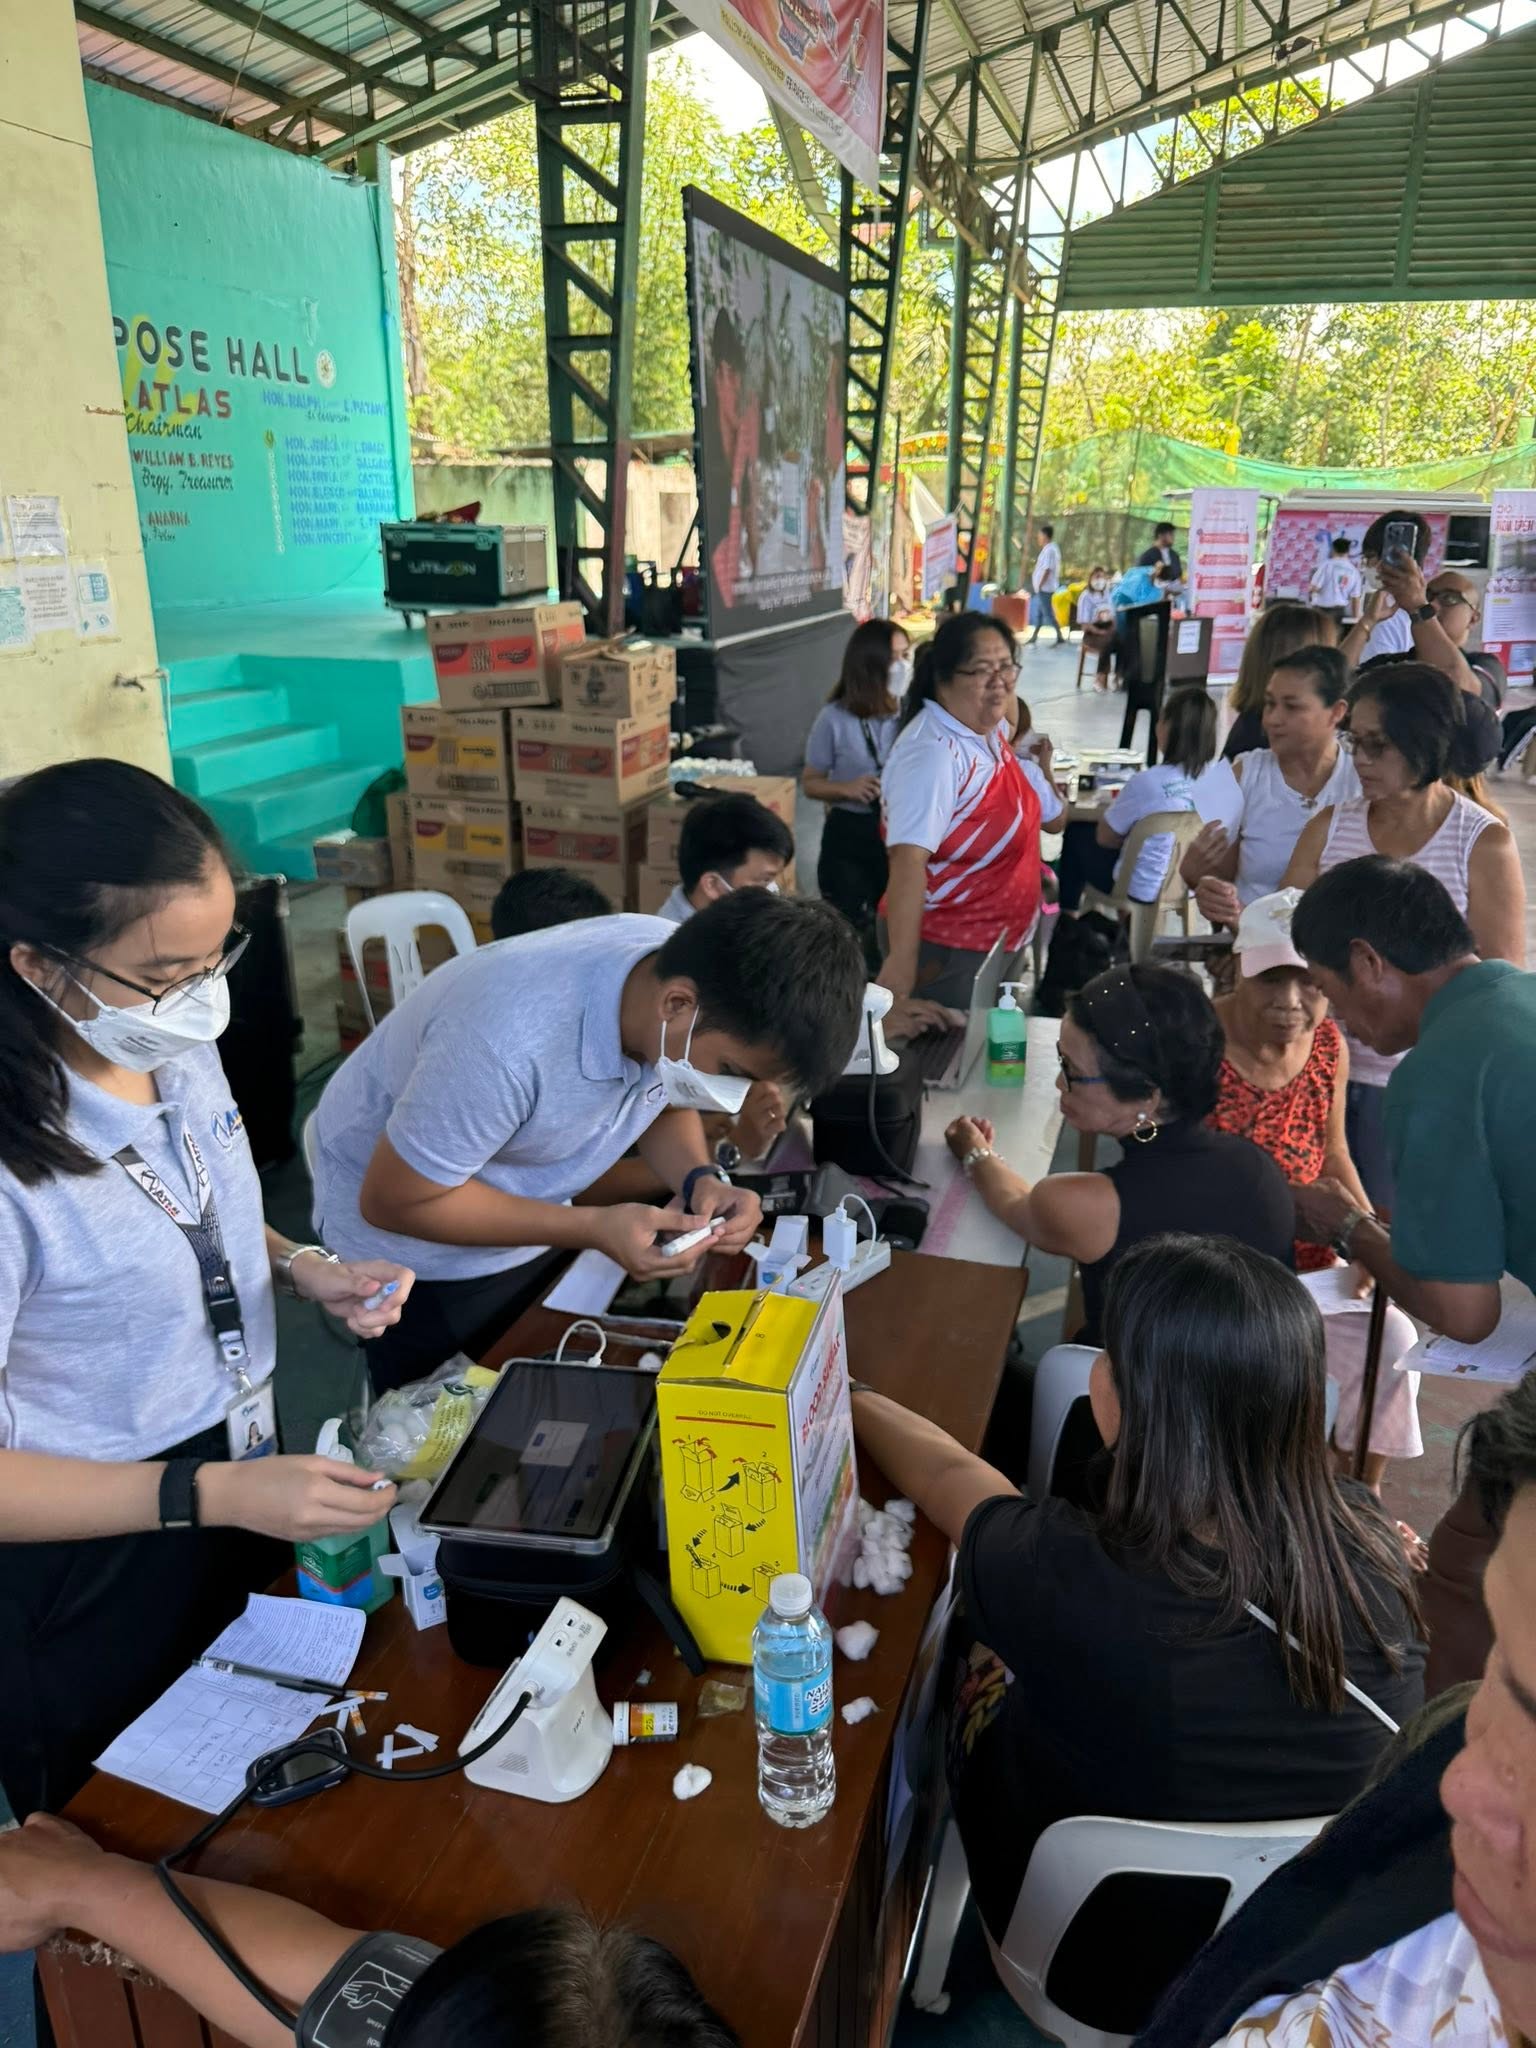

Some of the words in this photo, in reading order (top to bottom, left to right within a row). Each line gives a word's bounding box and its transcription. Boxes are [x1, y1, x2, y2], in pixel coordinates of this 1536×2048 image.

[226, 336, 310, 384] HALL
[138, 380, 231, 418] ATLAS
[126, 412, 202, 439] Chairman
[142, 467, 173, 495] Brgy.
